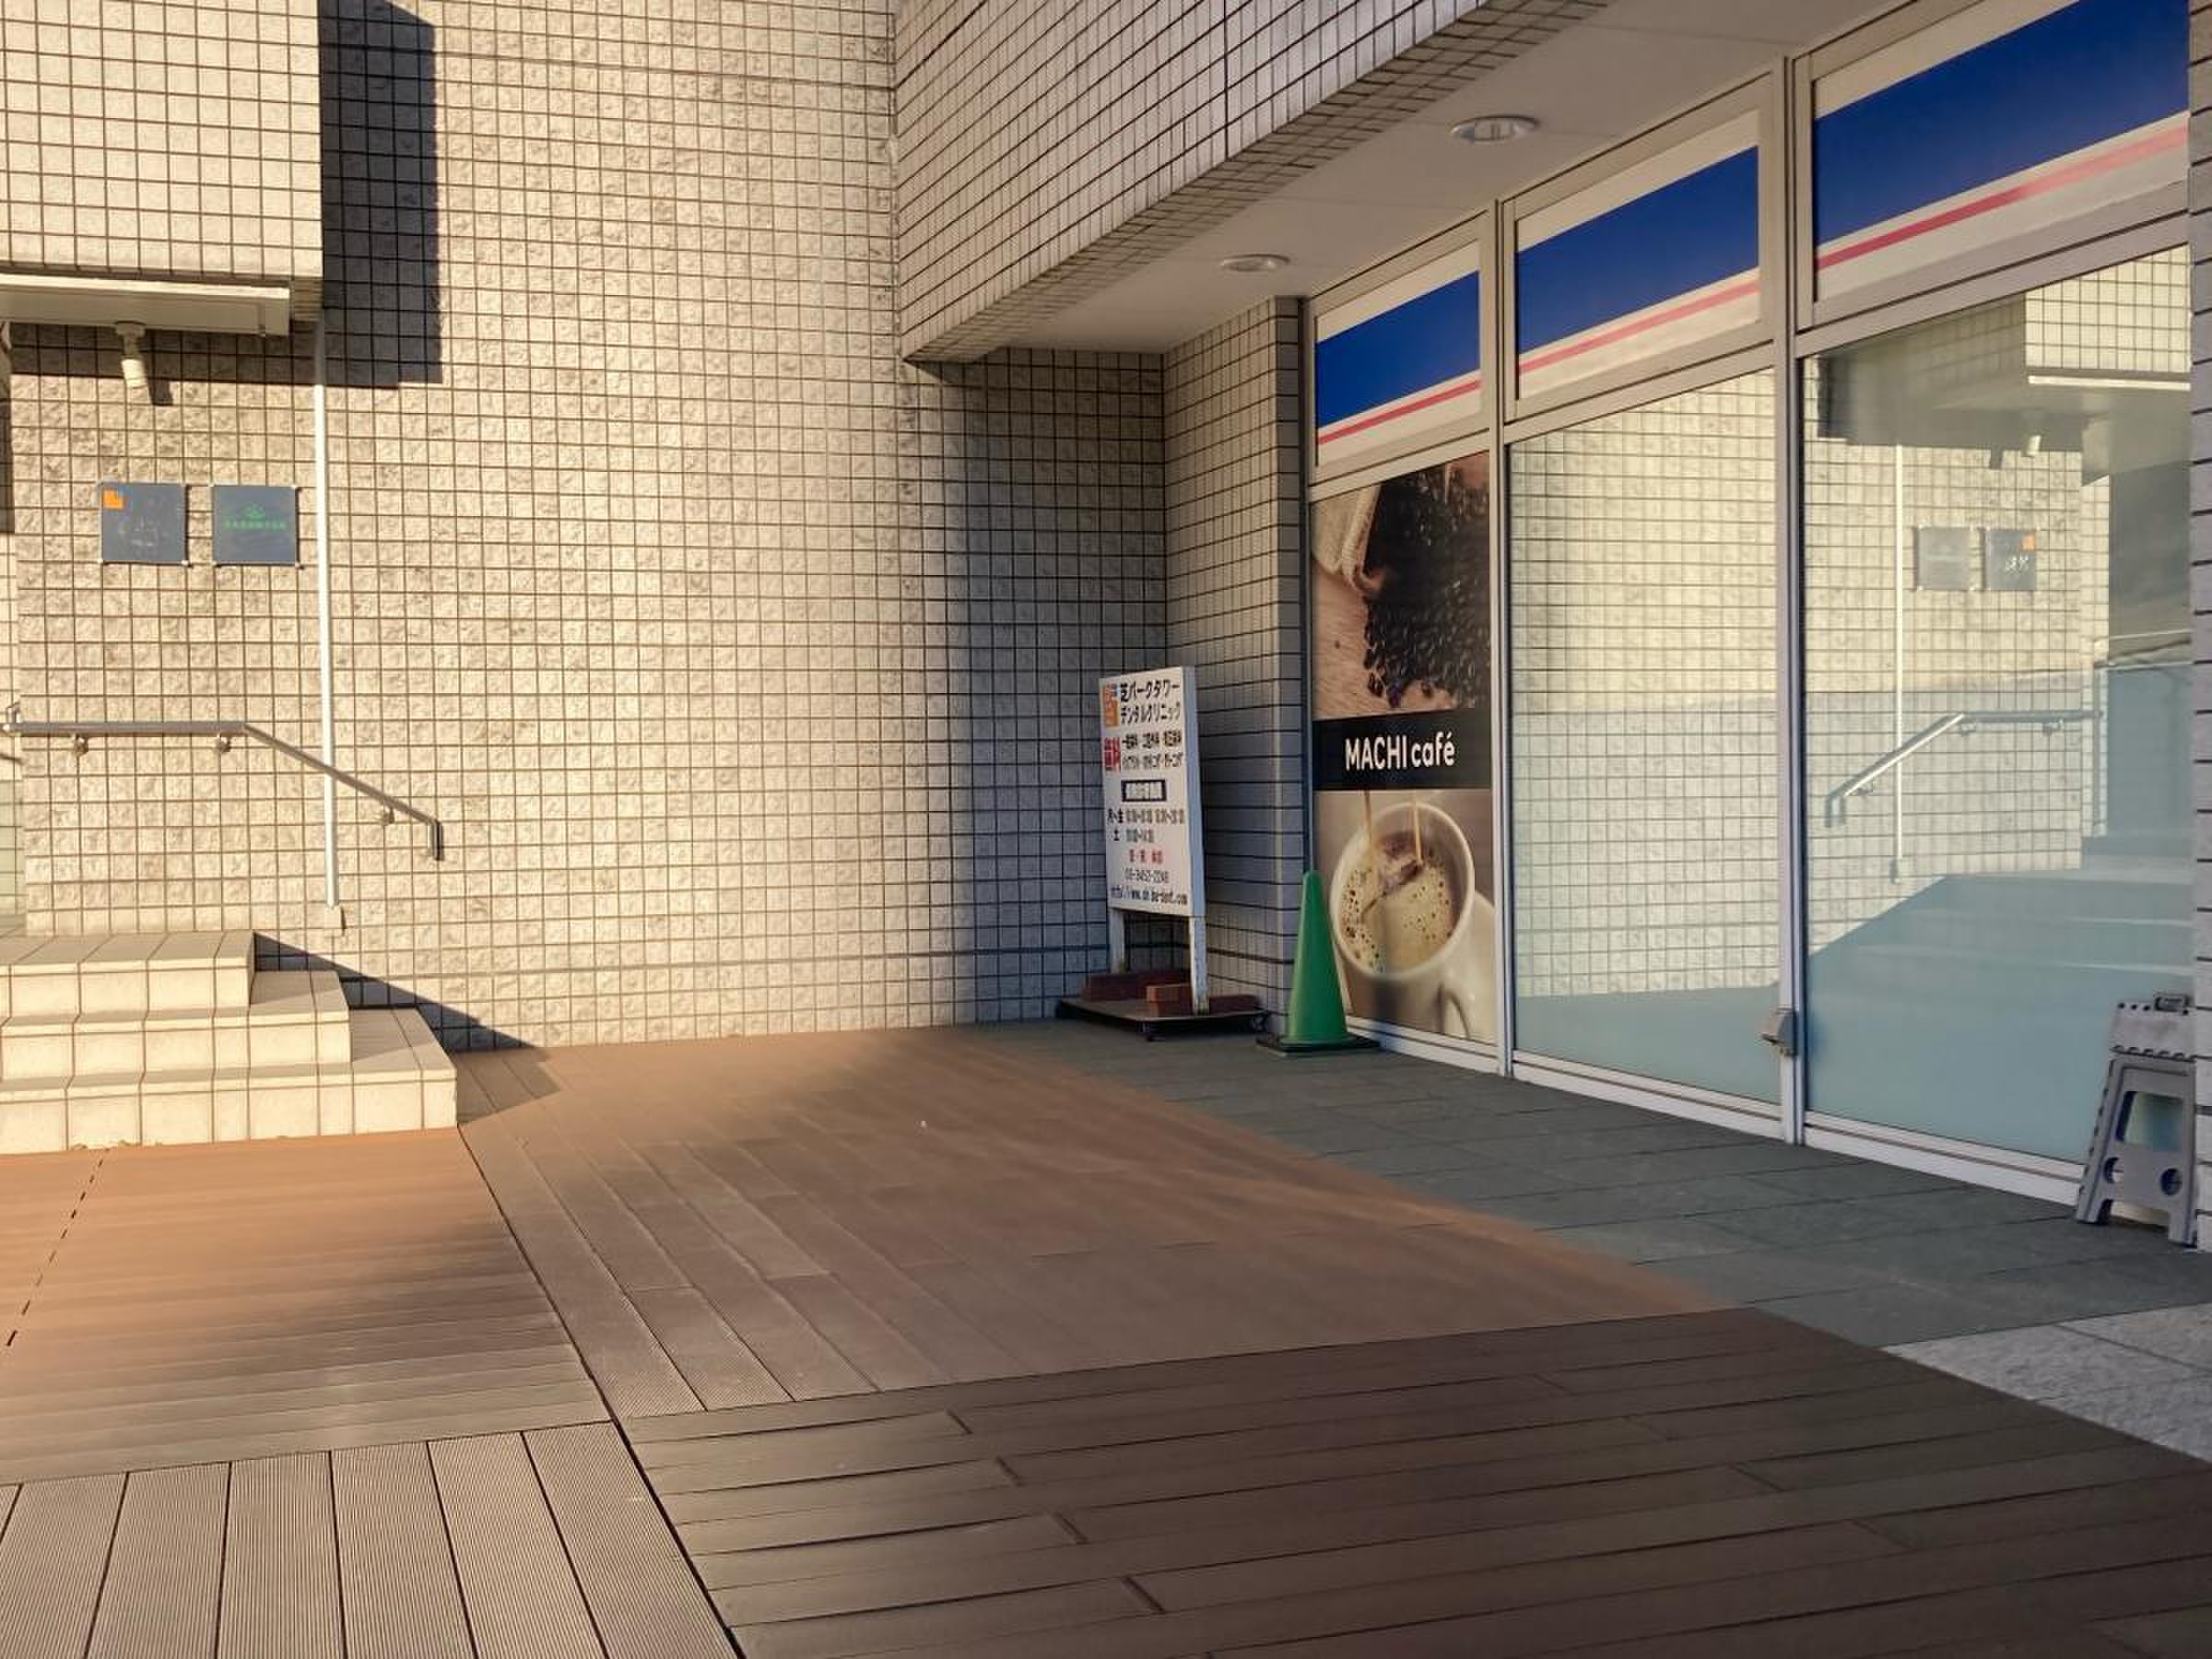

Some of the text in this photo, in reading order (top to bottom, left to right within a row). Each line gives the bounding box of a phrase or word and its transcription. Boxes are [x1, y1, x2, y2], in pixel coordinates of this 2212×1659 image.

[1121, 701, 1181, 724] デンタルクリニック
[1345, 732, 1455, 771] MACHI café
